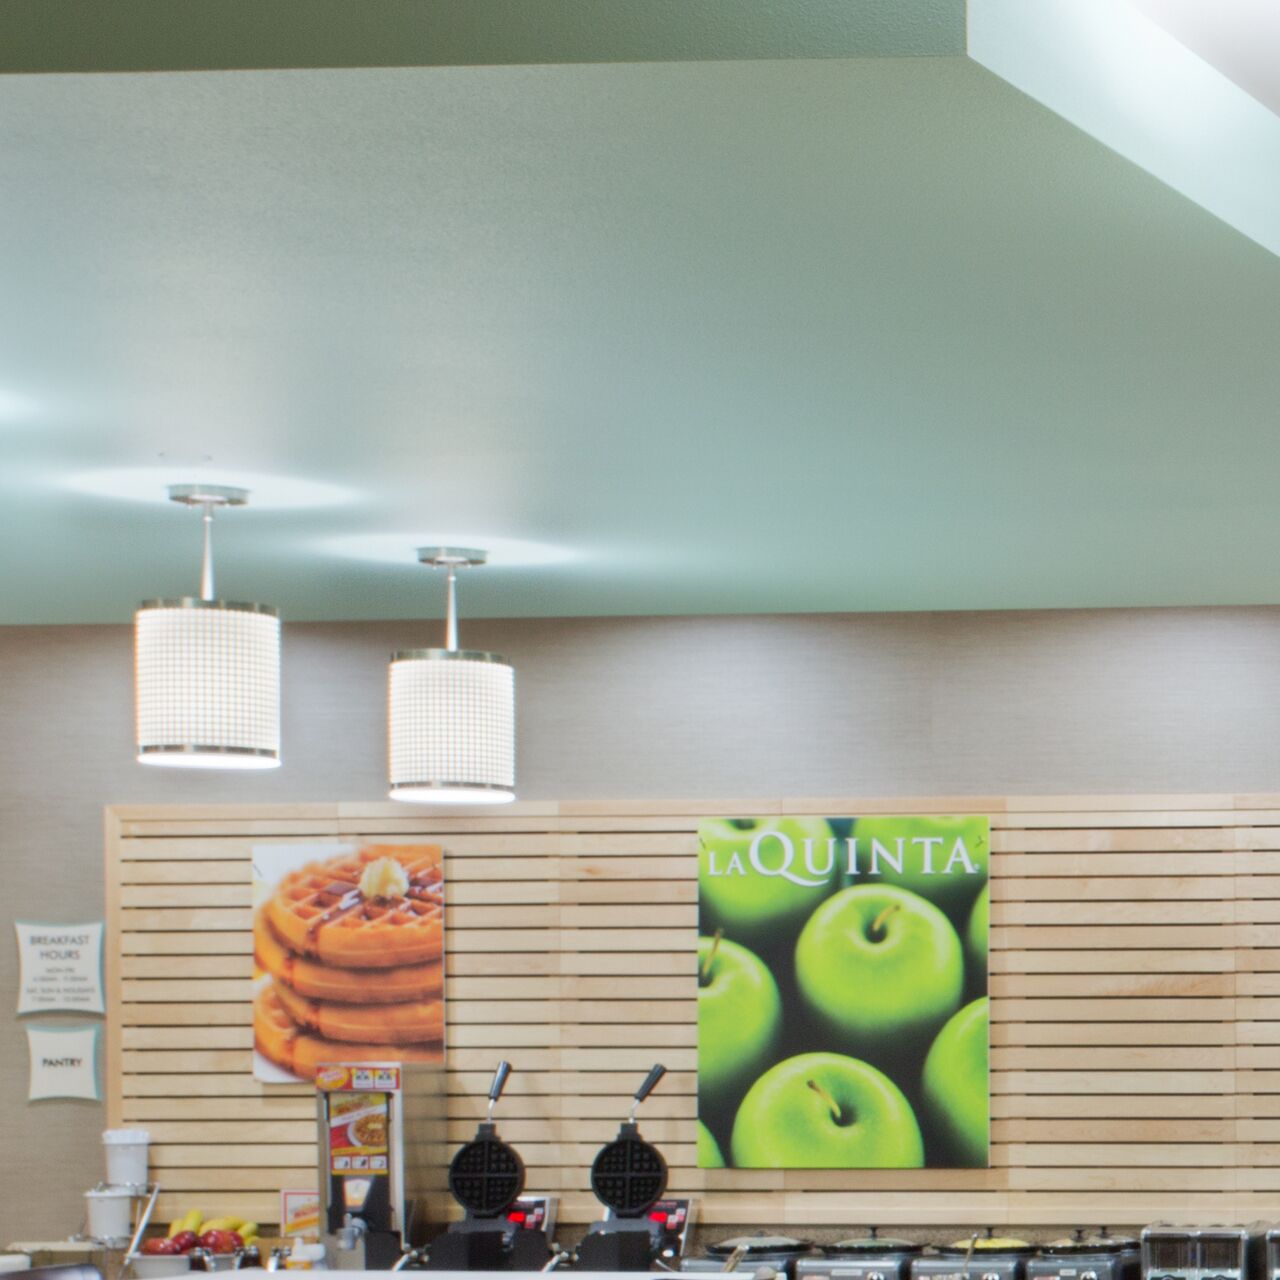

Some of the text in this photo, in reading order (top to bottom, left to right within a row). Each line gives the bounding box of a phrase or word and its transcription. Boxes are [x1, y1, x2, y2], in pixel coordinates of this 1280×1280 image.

[707, 851, 747, 876] LA
[30, 935, 90, 945] BREAKFAST
[40, 950, 80, 960] HOURS
[42, 1057, 83, 1068] PANTRY
